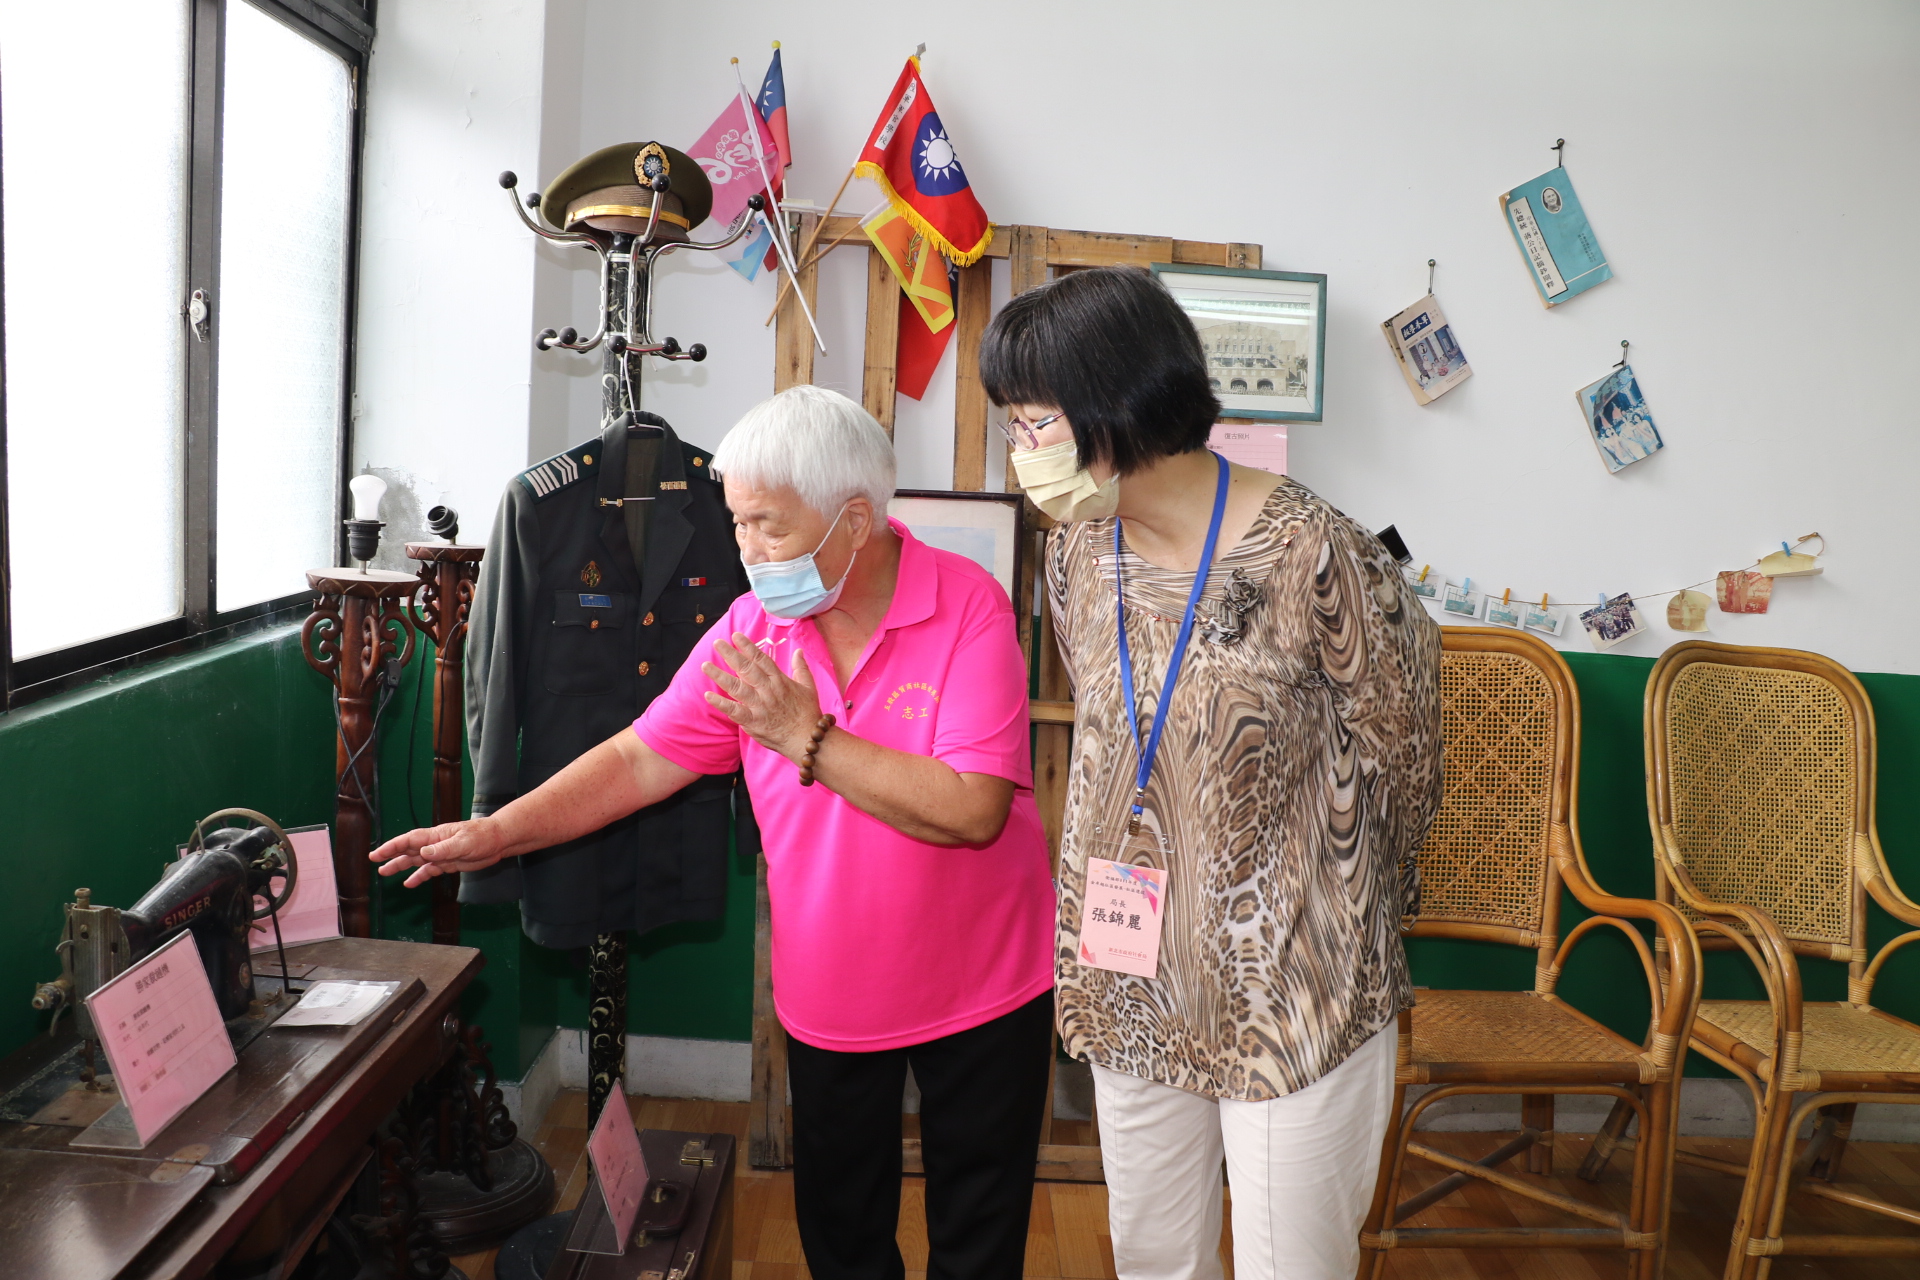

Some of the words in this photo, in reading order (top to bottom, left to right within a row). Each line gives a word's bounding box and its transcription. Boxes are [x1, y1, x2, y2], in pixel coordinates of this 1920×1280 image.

[901, 706, 929, 720] 志工
[164, 896, 212, 930] SINGER
[1110, 899, 1127, 909] 局長
[1091, 907, 1142, 931] 張錦麗
